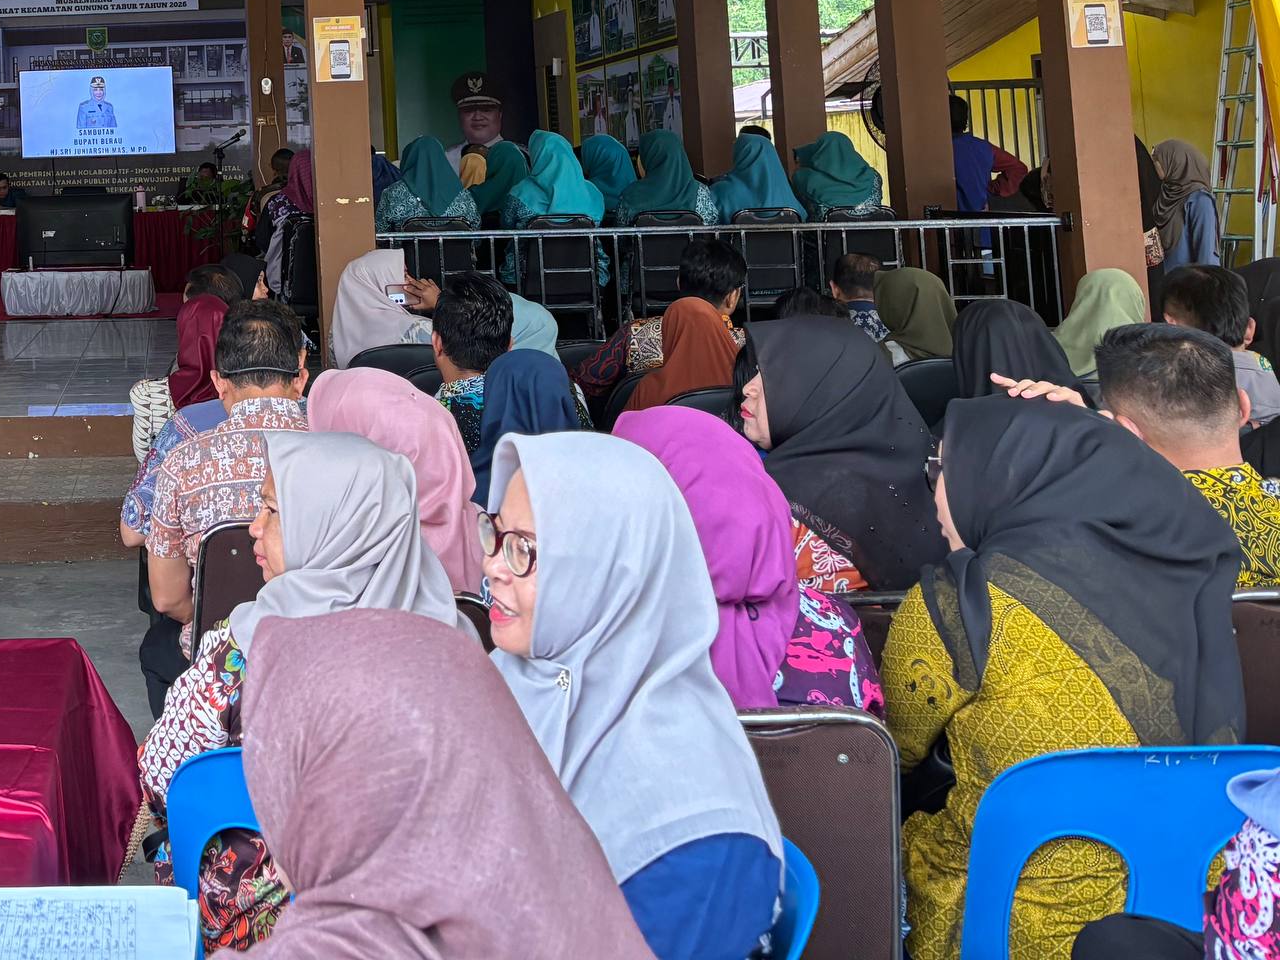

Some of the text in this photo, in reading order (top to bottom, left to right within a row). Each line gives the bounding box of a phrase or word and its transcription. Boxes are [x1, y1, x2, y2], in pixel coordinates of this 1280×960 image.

[20, 5, 73, 14] KECAMATAN
[74, 3, 109, 12] GUNUNG
[110, 2, 138, 11] TABUR
[138, 1, 168, 10] TAHUN
[78, 128, 115, 137] SAMBUTAN
[73, 137, 123, 146] BUPATI BERAU
[78, 167, 130, 176] KOLABORATIF
[135, 166, 171, 175] INOVATIF
[83, 176, 110, 185] PUBLIK
[111, 175, 129, 184] DAN
[129, 174, 181, 183] PERWUJUDAN
